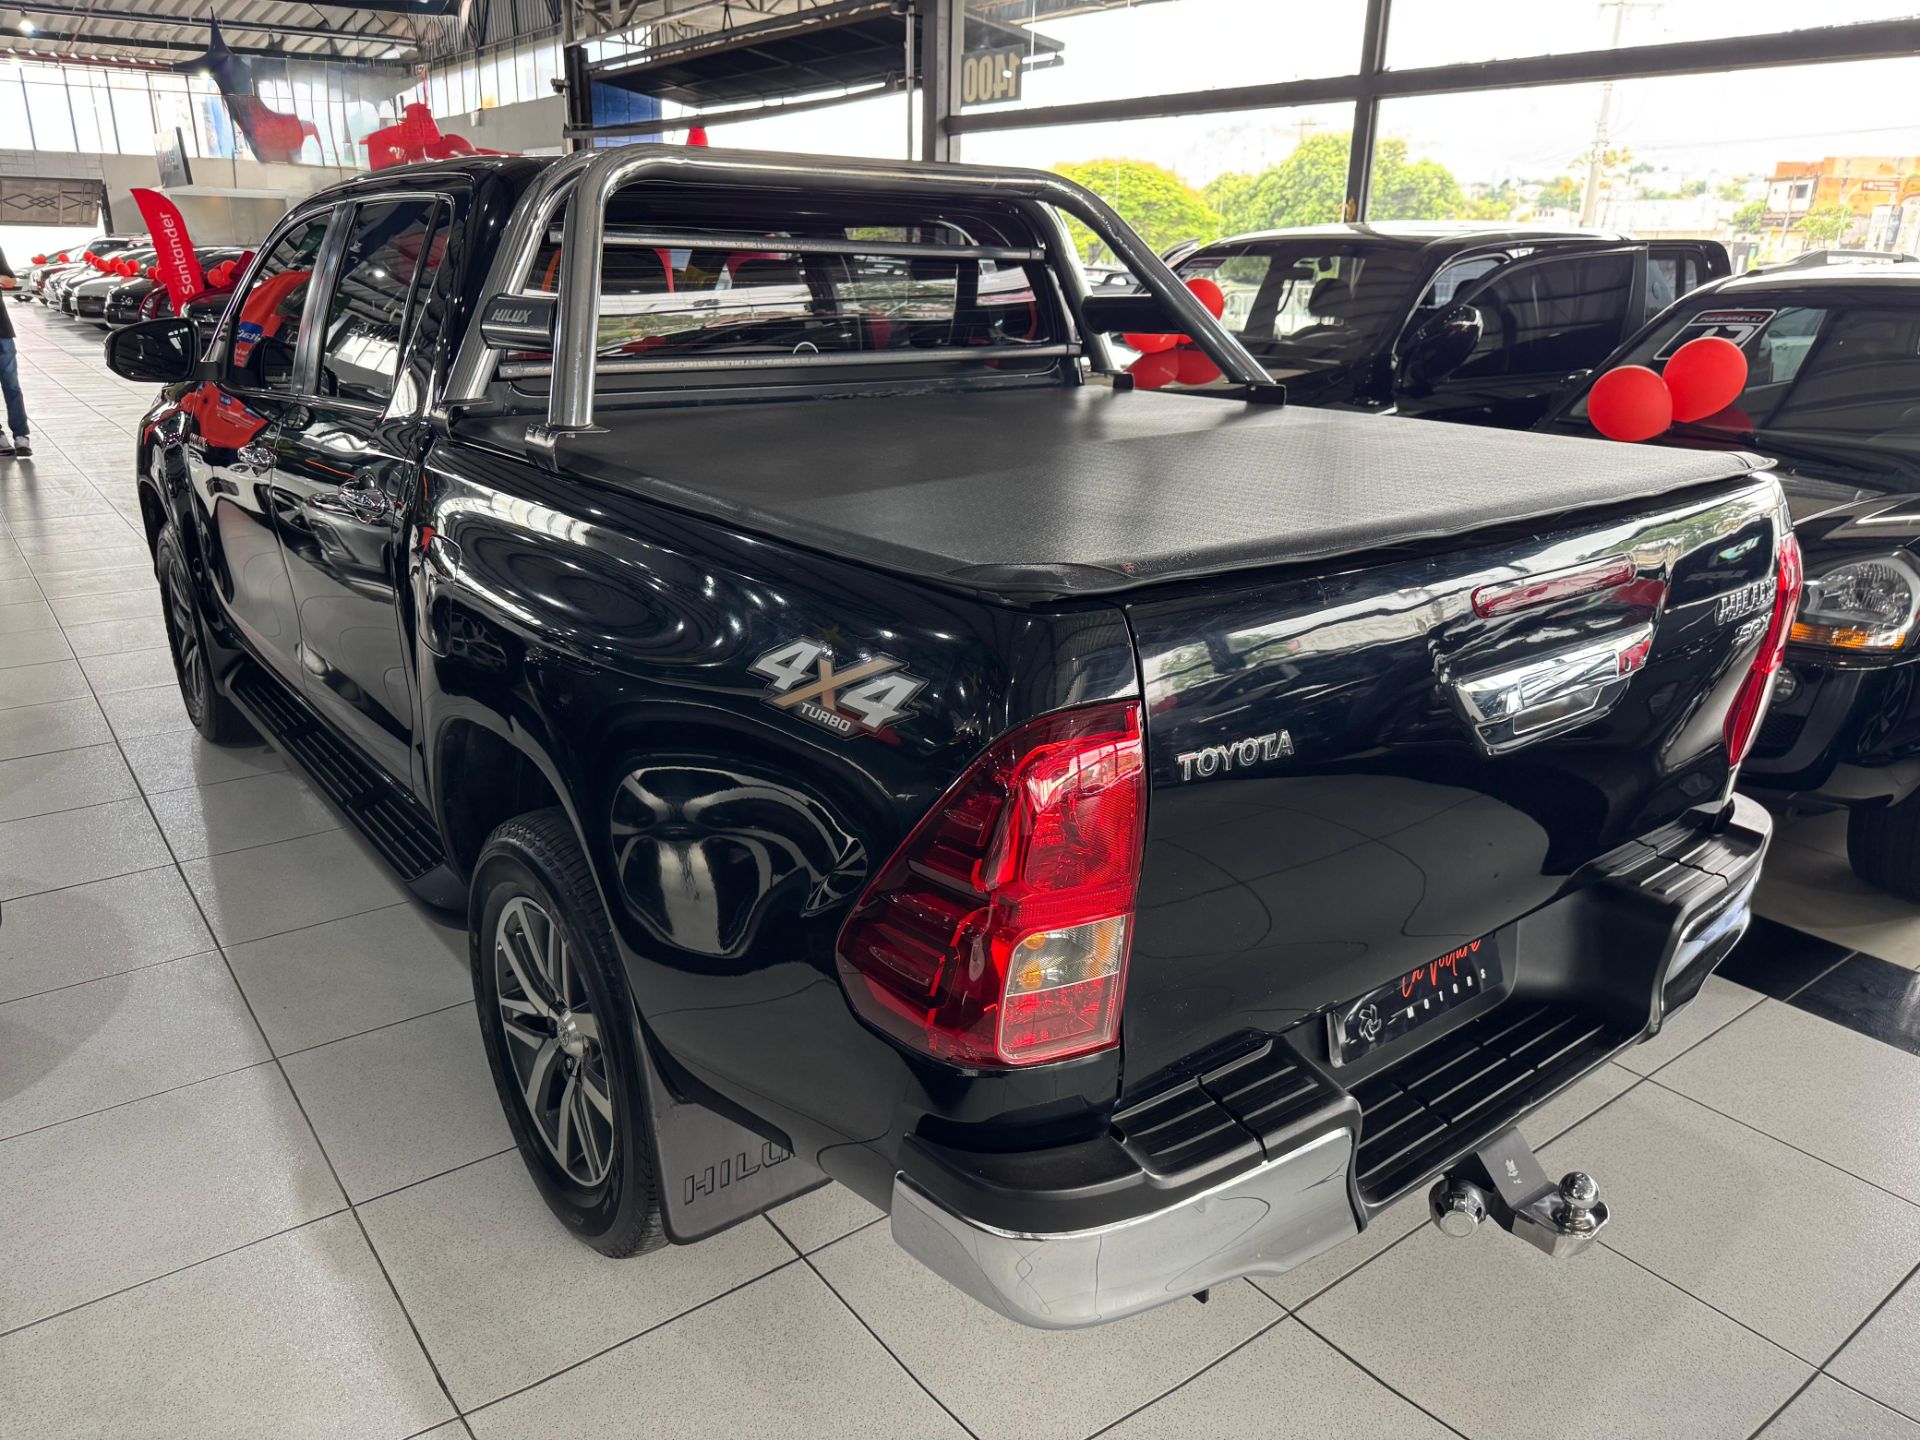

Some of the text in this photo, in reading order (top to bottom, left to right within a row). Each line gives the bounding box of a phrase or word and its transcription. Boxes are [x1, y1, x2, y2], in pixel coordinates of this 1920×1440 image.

[160, 211, 195, 295] Santander
[491, 308, 532, 323] HILUX
[801, 702, 851, 732] TURBO
[1175, 728, 1294, 781] TOYOTA
[1406, 967, 1487, 1019] MOTORS
[684, 1140, 793, 1206] HILU
